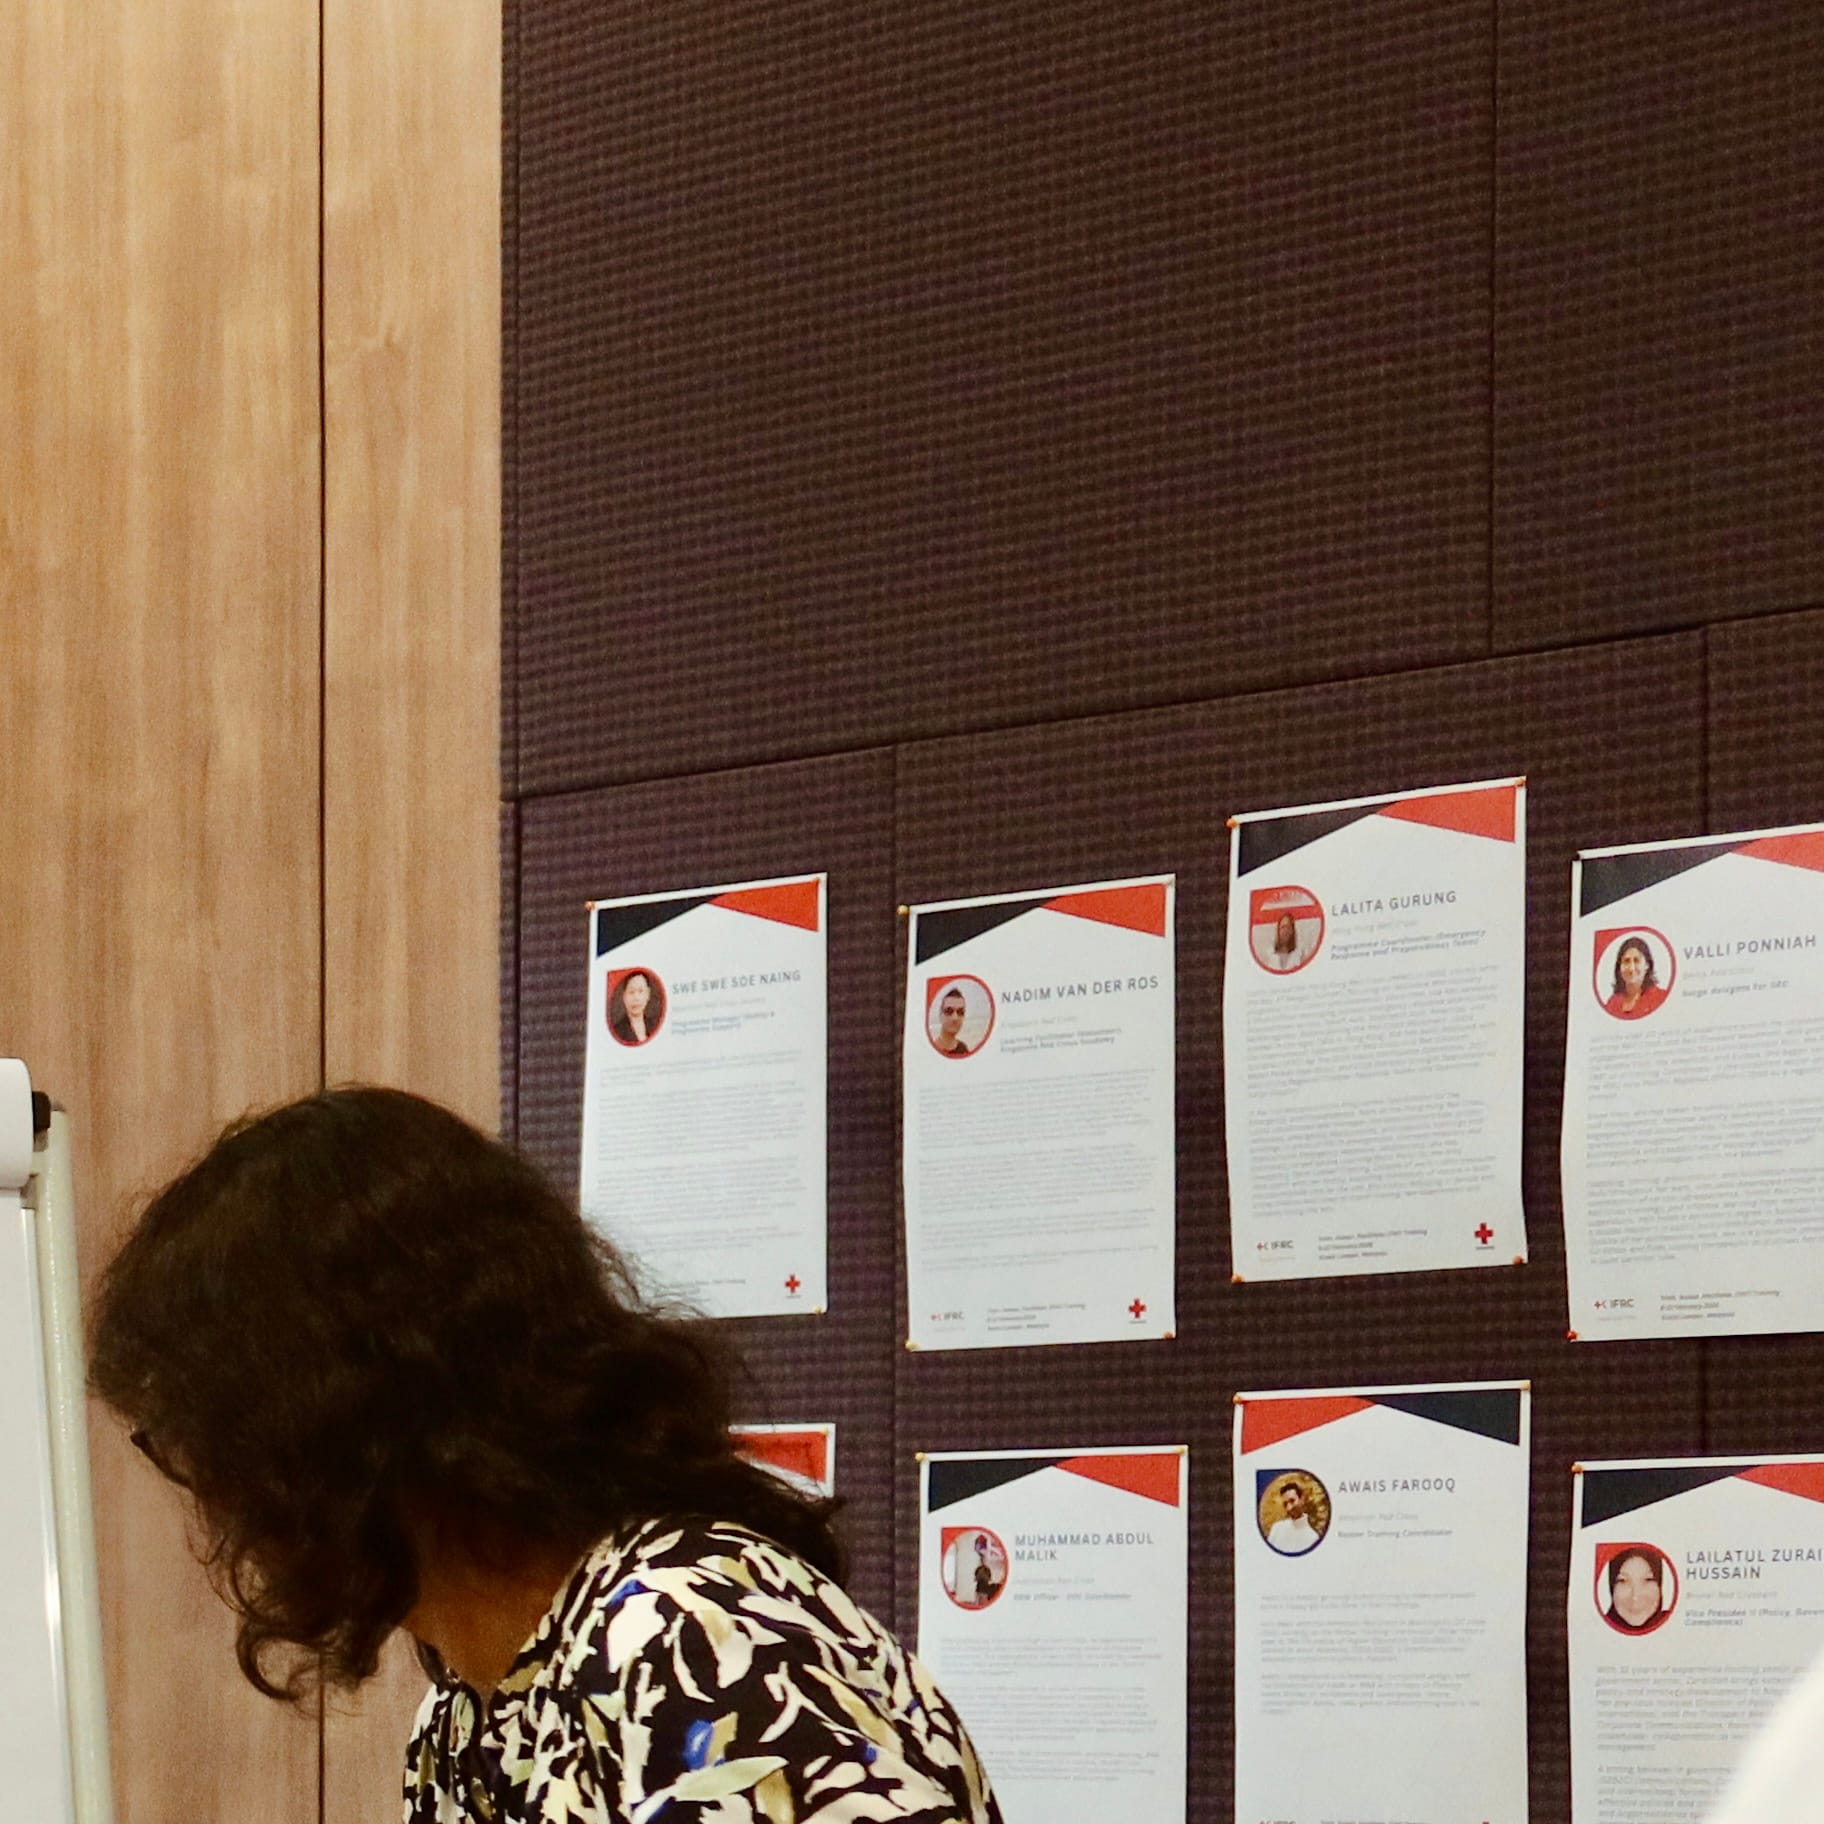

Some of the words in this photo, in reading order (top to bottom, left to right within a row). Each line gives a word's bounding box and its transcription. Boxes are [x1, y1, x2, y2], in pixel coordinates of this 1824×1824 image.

[1331, 898, 1383, 916] LALITA
[1388, 890, 1457, 911] GURUNG
[1683, 945, 1731, 960] VALLI
[1736, 935, 1817, 955] PONNIAH
[672, 982, 698, 995] SWE
[702, 979, 727, 992] SWE
[731, 975, 755, 988] SOE
[759, 969, 801, 985] NAING
[1002, 987, 1051, 1003] NADIM
[1057, 983, 1088, 998] VAN
[1093, 979, 1122, 994] DER
[1127, 975, 1159, 991] ROS
[1338, 1479, 1387, 1494] AWAIS
[1391, 1477, 1456, 1494] FAROOQ
[1015, 1533, 1101, 1547] MUHAMMAD
[1105, 1532, 1155, 1546] ABDUL
[1015, 1549, 1058, 1562] MALIK
[1686, 1549, 1765, 1564] LAILATUL
[1686, 1567, 1761, 1580] HUSSAIN
